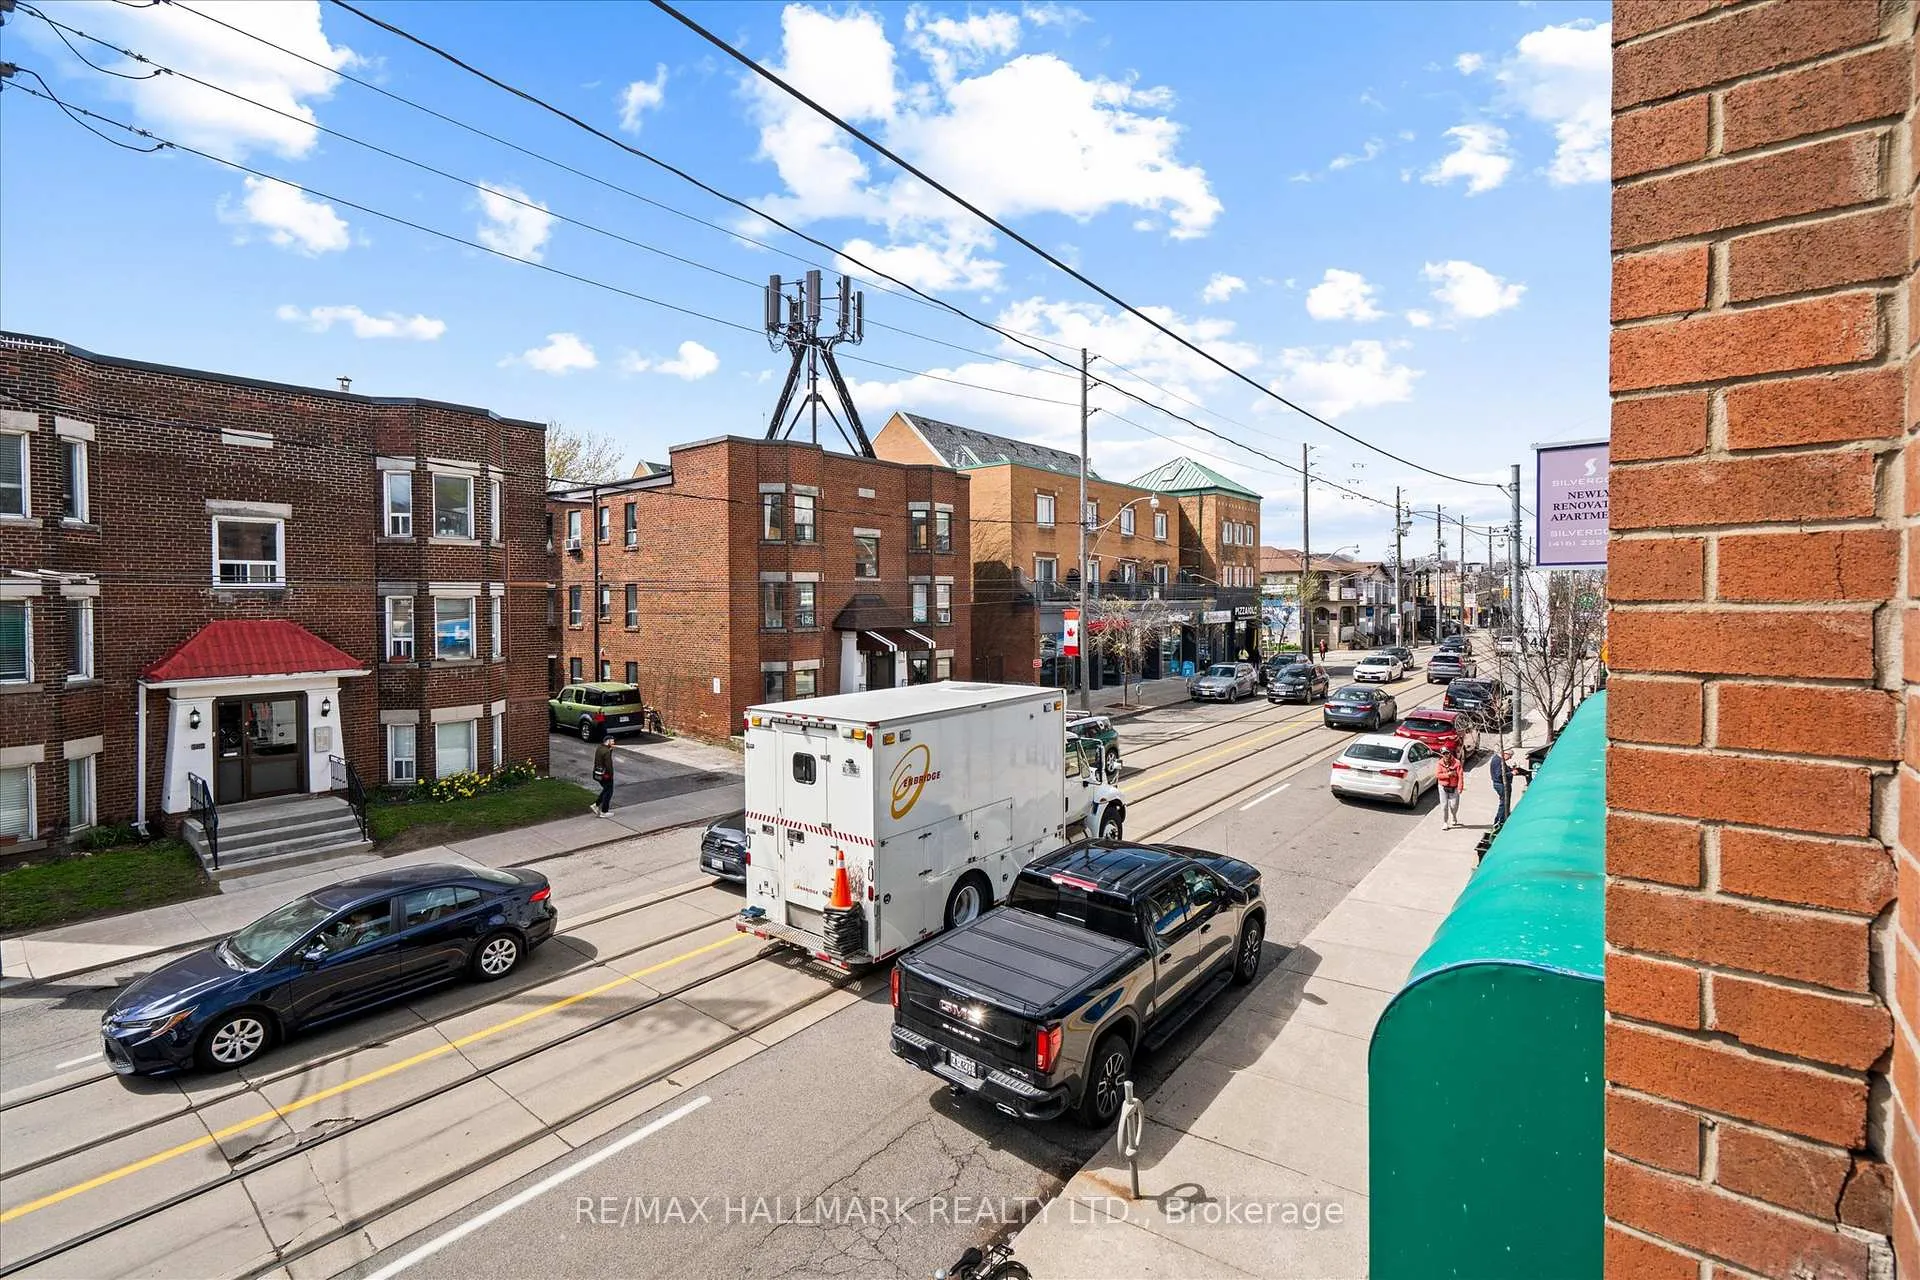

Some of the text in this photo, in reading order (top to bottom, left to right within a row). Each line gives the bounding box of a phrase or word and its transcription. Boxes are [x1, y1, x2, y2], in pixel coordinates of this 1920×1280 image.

[1567, 489, 1609, 500] NEWLY
[1553, 500, 1608, 511] RENOVAT
[1550, 512, 1608, 522] APARTME
